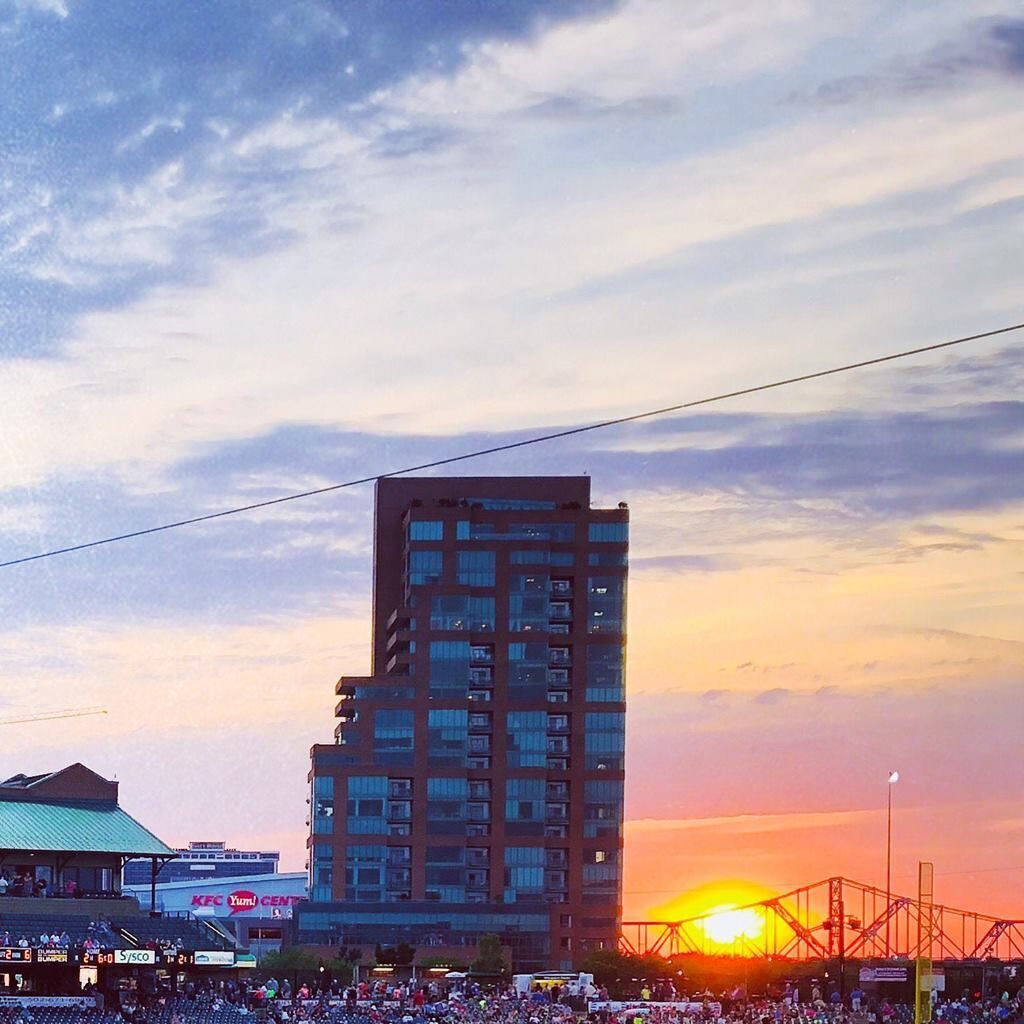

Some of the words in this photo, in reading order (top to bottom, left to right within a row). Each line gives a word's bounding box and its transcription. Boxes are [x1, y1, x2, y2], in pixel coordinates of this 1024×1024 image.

[191, 895, 224, 906] KFC
[230, 895, 257, 906] Yum!
[260, 895, 309, 906] CENT
[5, 949, 12, 960] 2
[24, 949, 30, 960] 6
